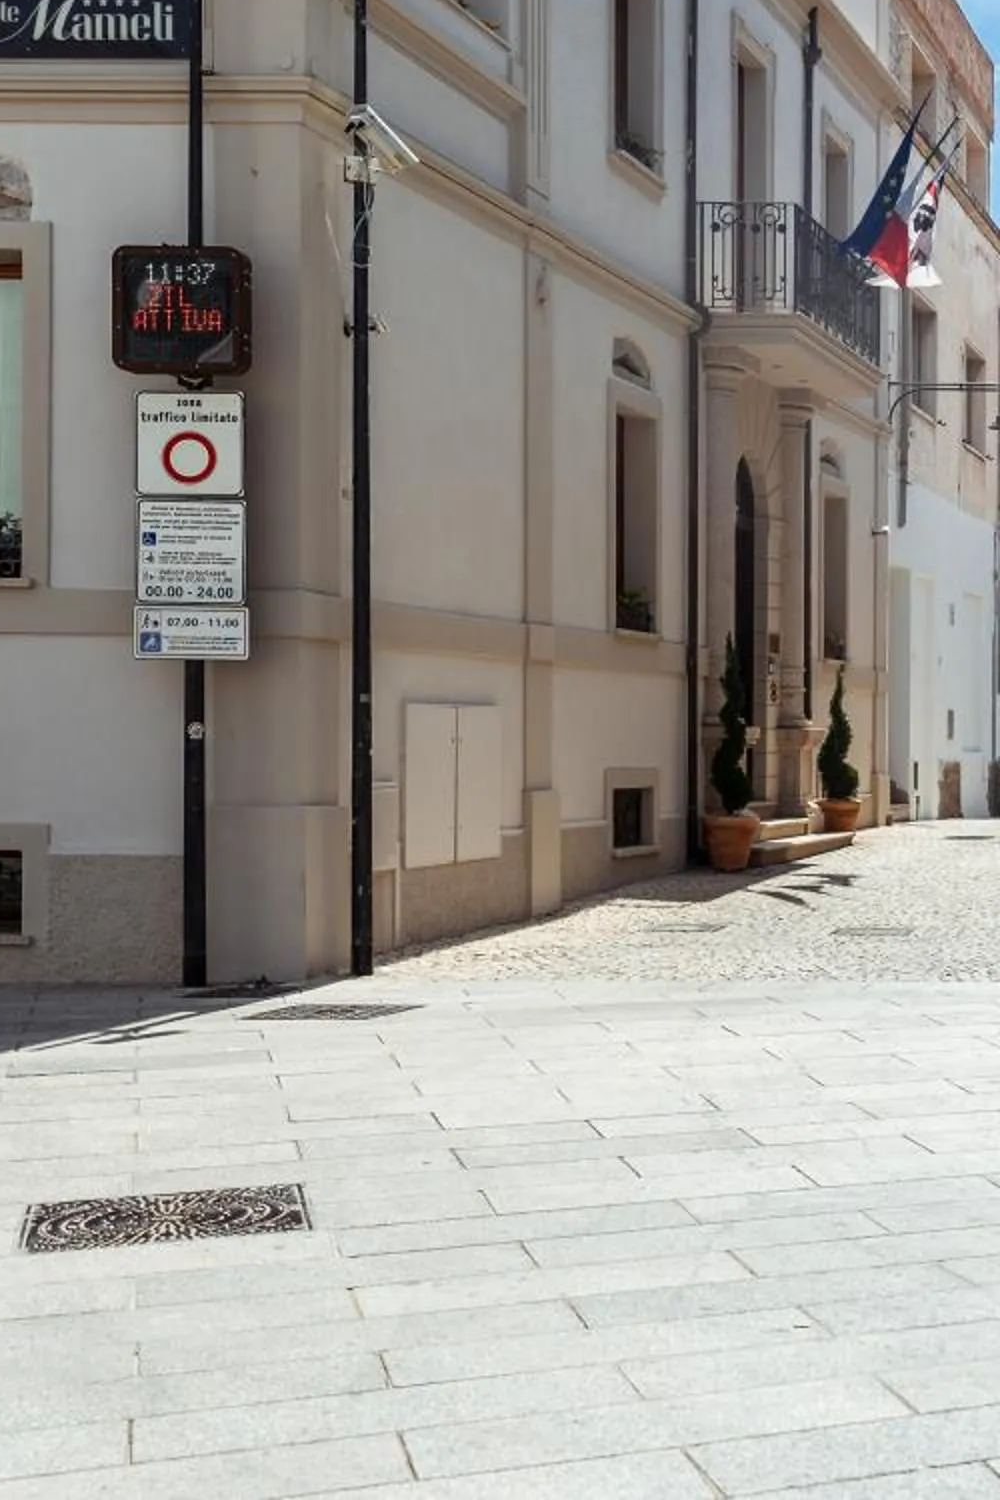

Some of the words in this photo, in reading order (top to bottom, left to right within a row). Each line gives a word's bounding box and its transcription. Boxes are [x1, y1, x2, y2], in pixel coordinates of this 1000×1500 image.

[145, 263, 215, 285] 11:37
[148, 284, 193, 308] ZTL
[132, 308, 222, 332] ATTIVA
[140, 411, 187, 423] traffico
[191, 411, 239, 423] limitato
[145, 585, 184, 597] 00.00
[197, 586, 234, 599] 24.00
